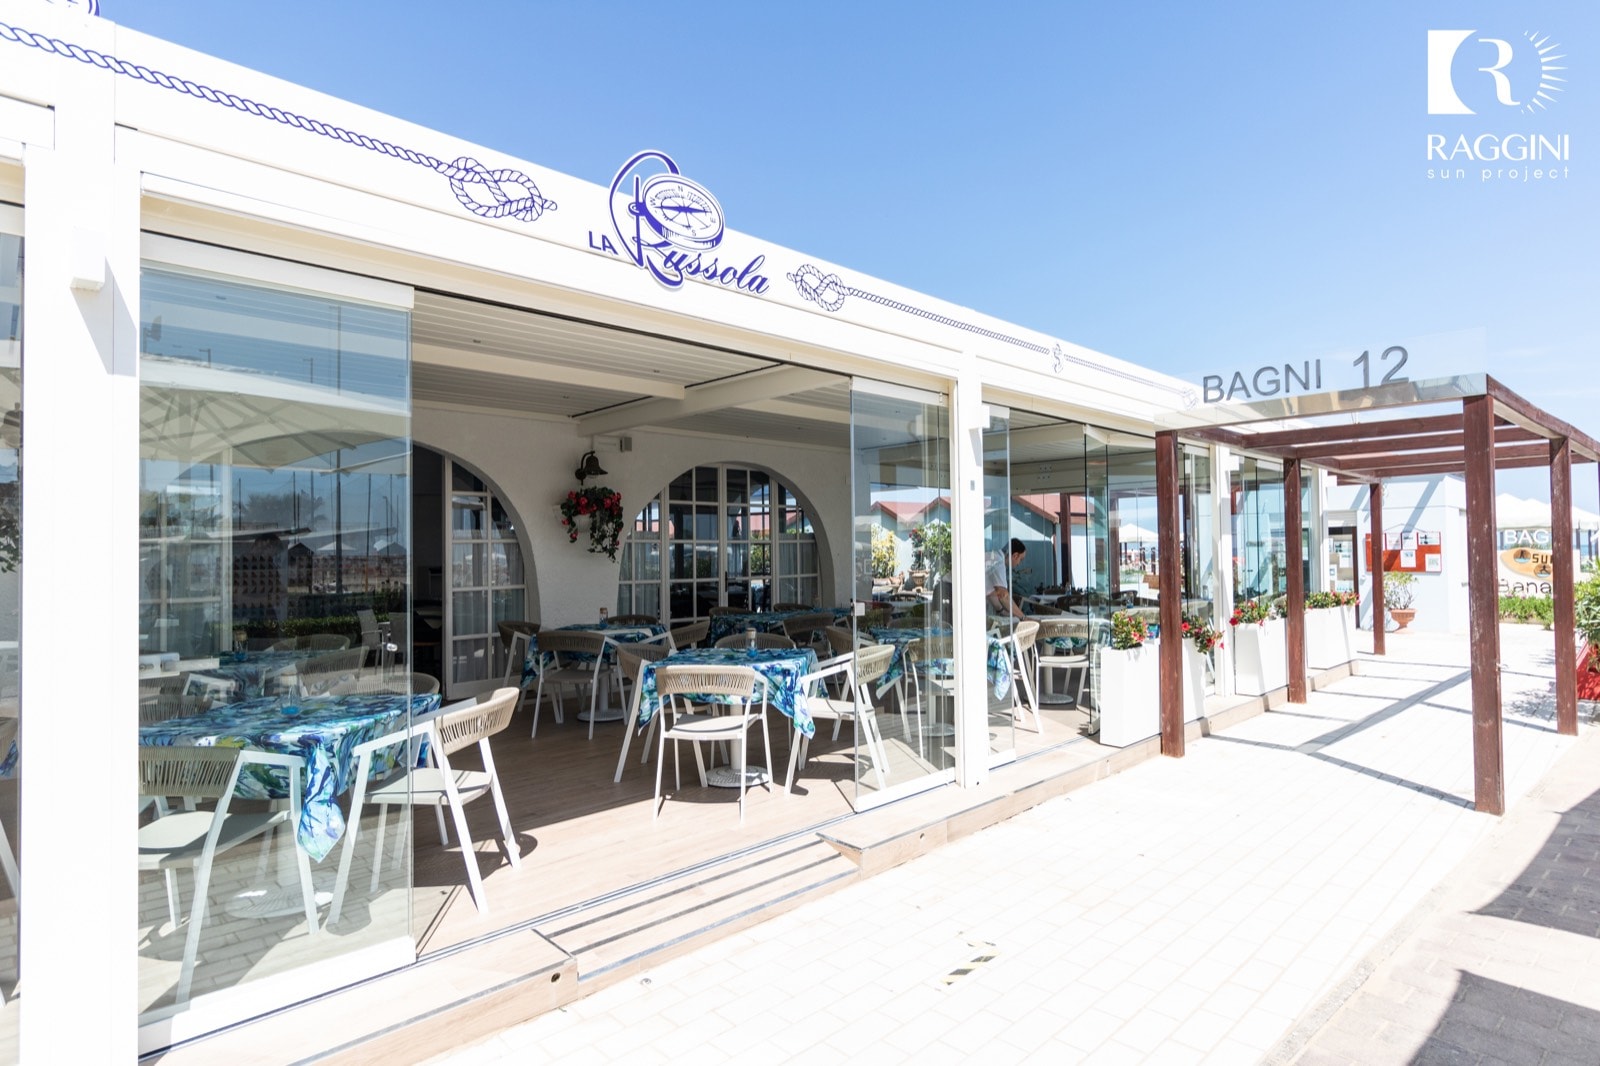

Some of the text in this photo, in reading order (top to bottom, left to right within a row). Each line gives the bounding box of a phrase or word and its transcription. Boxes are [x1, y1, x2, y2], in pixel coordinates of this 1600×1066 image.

[588, 230, 619, 255] LA
[1203, 345, 1410, 404] BAGNI 12
[1504, 529, 1550, 545] BAG
[1532, 552, 1553, 564] SU
[1498, 578, 1553, 595] Bana
